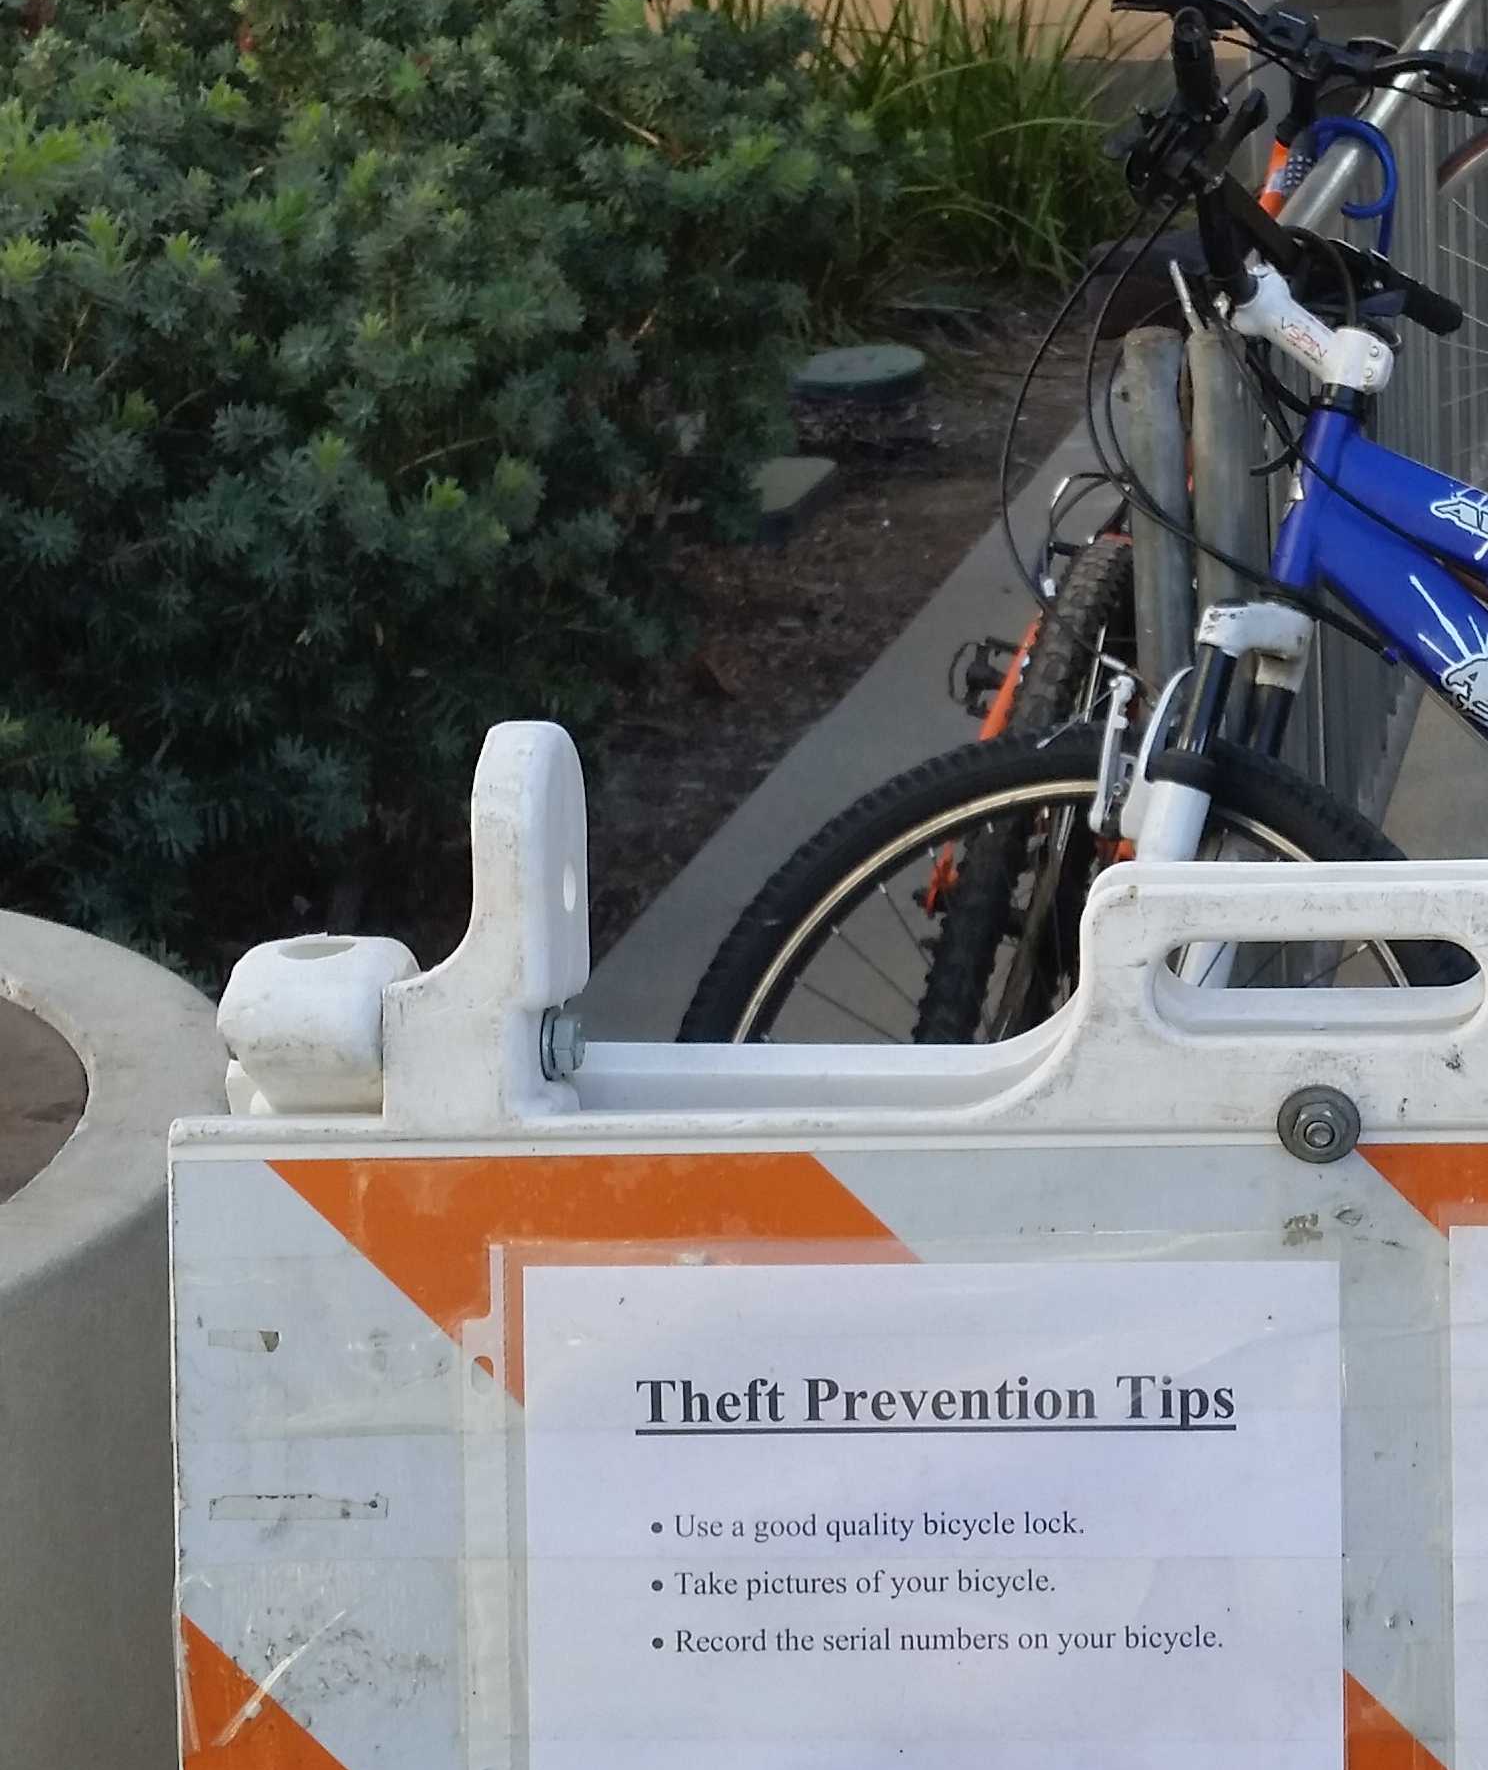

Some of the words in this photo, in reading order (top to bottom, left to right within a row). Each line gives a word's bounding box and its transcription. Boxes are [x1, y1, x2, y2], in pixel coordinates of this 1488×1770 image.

[636, 1378, 785, 1422] Theft
[803, 1376, 1097, 1421] Prevention
[1117, 1376, 1234, 1427] Tips
[676, 1515, 723, 1537] Use
[732, 1521, 744, 1537] a
[755, 1513, 816, 1543] good
[826, 1512, 914, 1542] quality
[924, 1511, 1015, 1541] bicycle
[1025, 1511, 1083, 1534] lock.
[674, 1571, 737, 1595] Take
[747, 1571, 846, 1601] pictures
[856, 1570, 885, 1593] of
[891, 1576, 949, 1599] your
[958, 1568, 1055, 1598] bicycle.
[677, 1629, 766, 1652] Record
[776, 1629, 814, 1651] the
[824, 1627, 890, 1651] serial
[901, 1627, 1008, 1650] numbers
[1019, 1633, 1048, 1649] on
[1058, 1633, 1116, 1655] your
[1125, 1625, 1222, 1654] bicycle.
